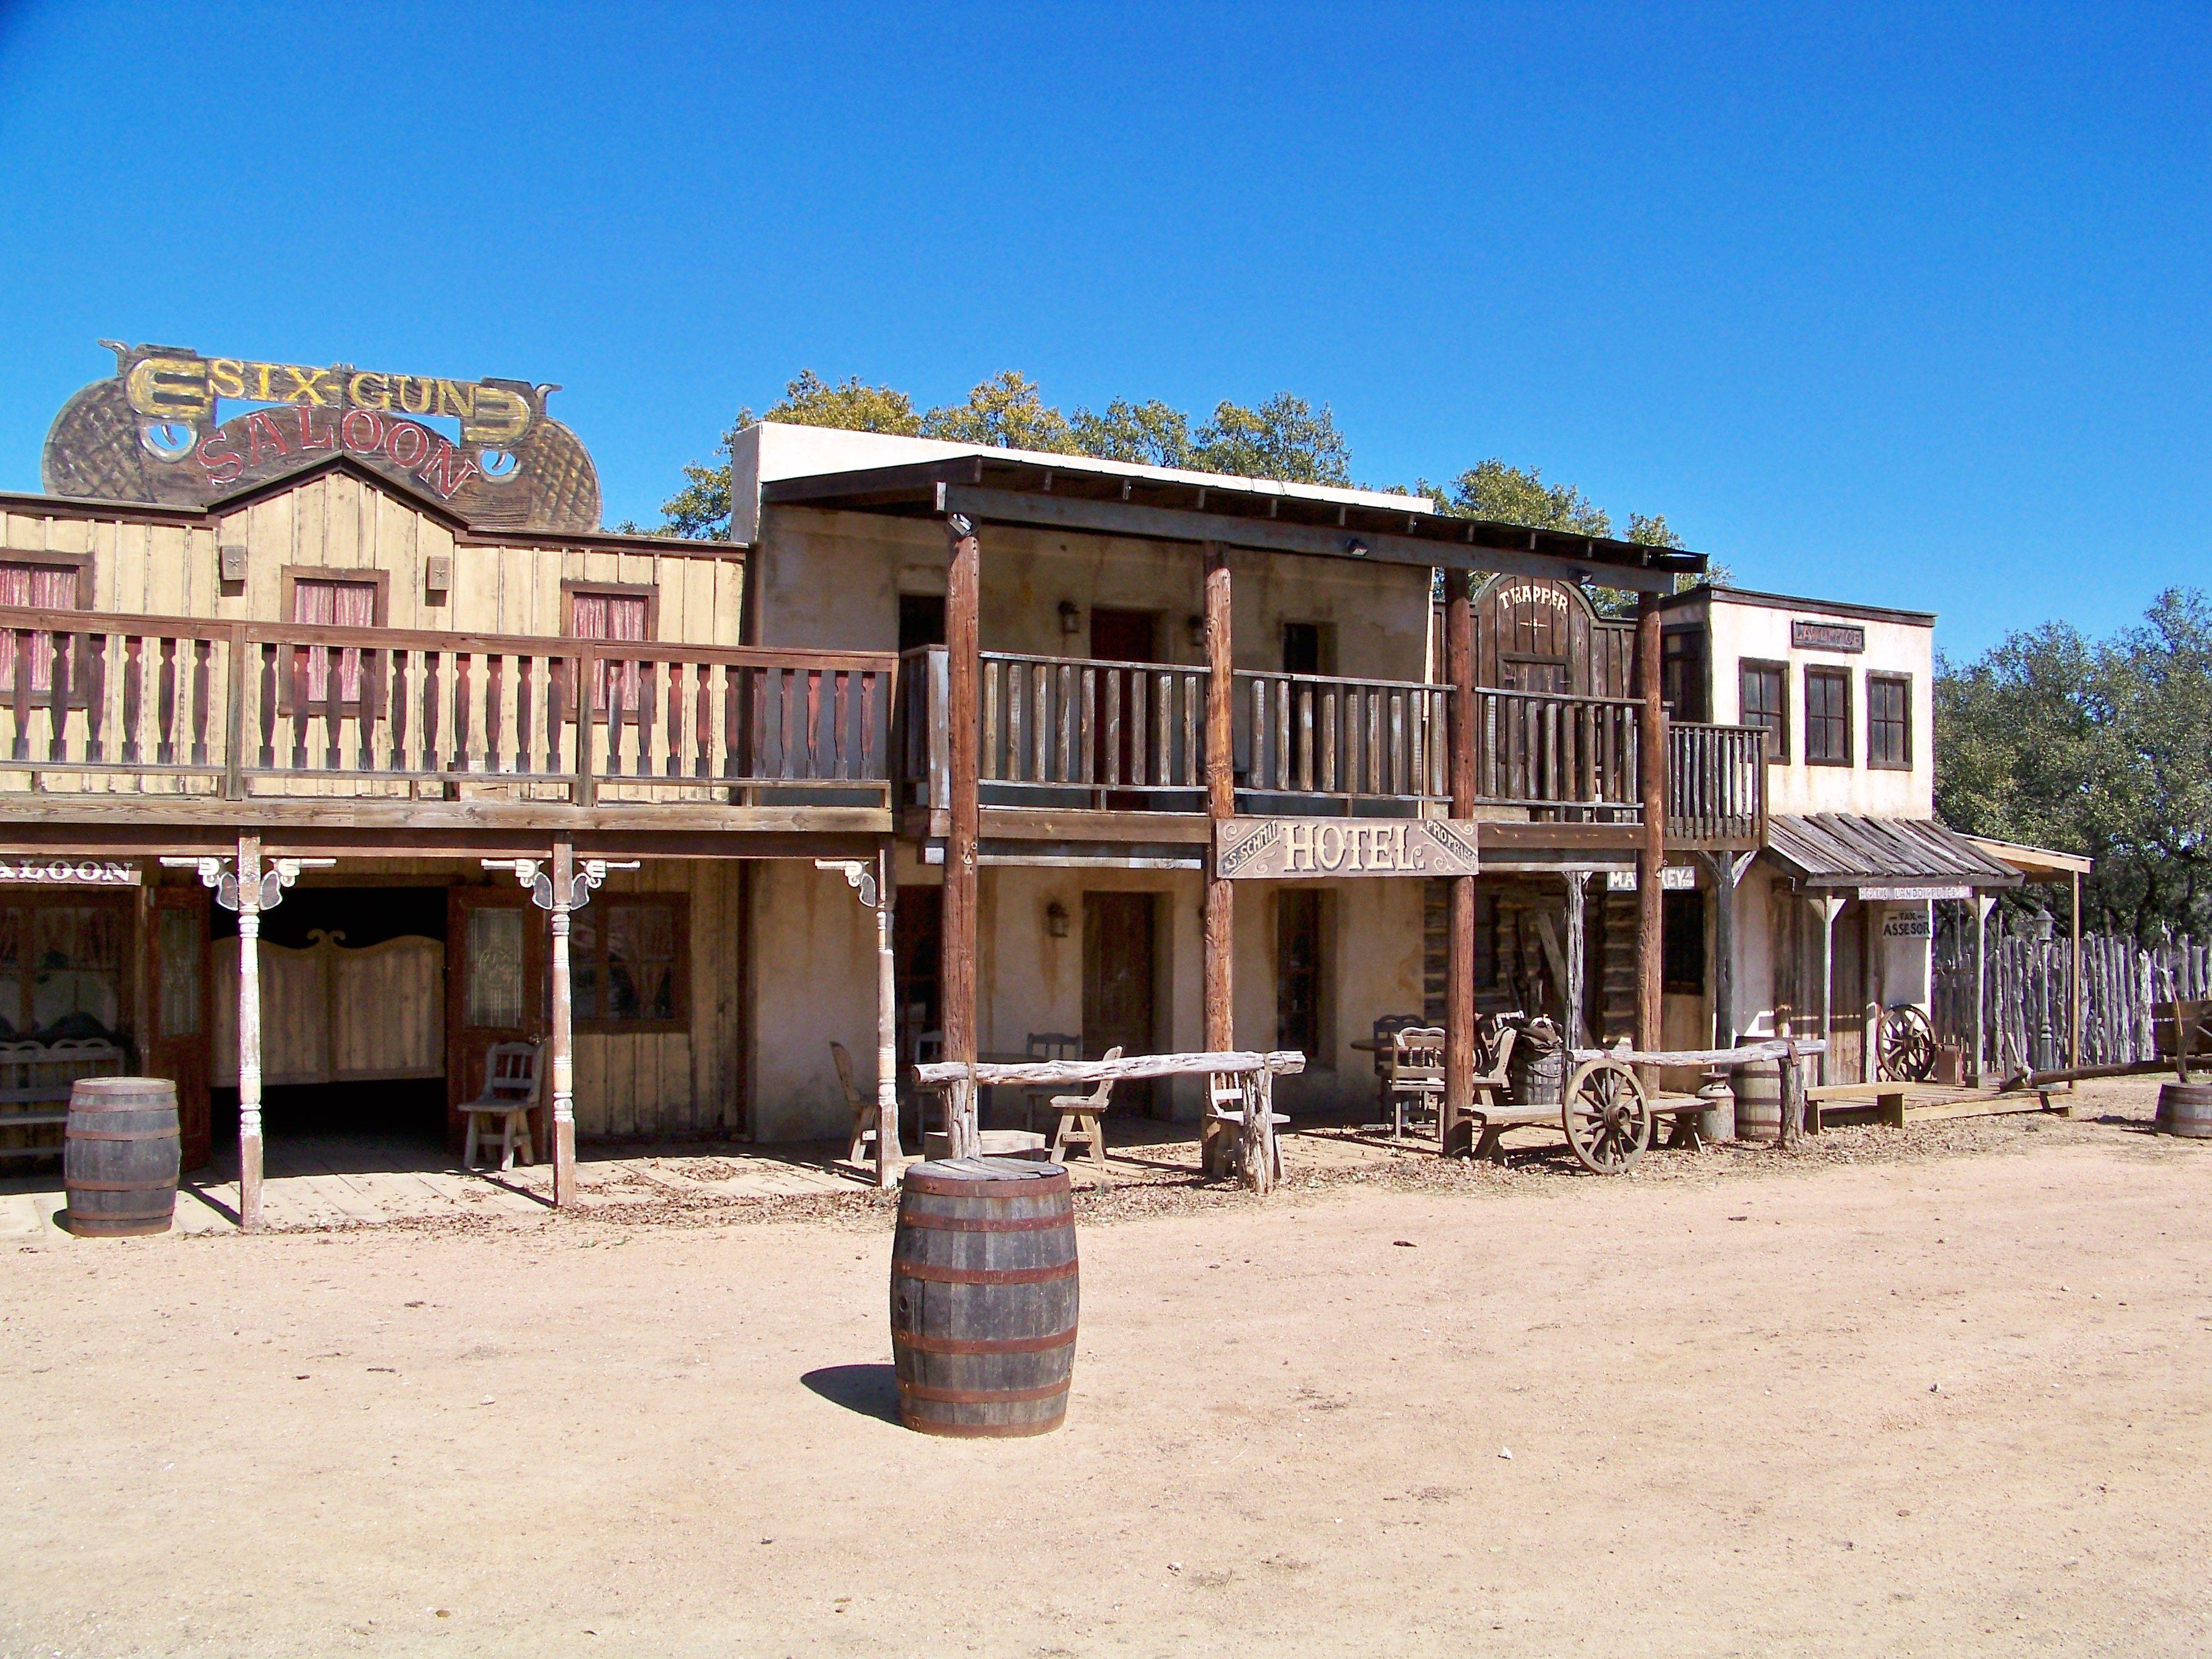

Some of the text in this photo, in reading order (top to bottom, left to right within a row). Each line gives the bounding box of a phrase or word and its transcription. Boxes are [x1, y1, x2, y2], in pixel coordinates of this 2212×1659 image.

[207, 359, 478, 417] SIX-GUN
[195, 405, 479, 500] SALOON
[1499, 585, 1569, 614] TRAPPER
[1240, 819, 1278, 861] SCHMIT
[1883, 922, 1931, 936] ASSESOR
